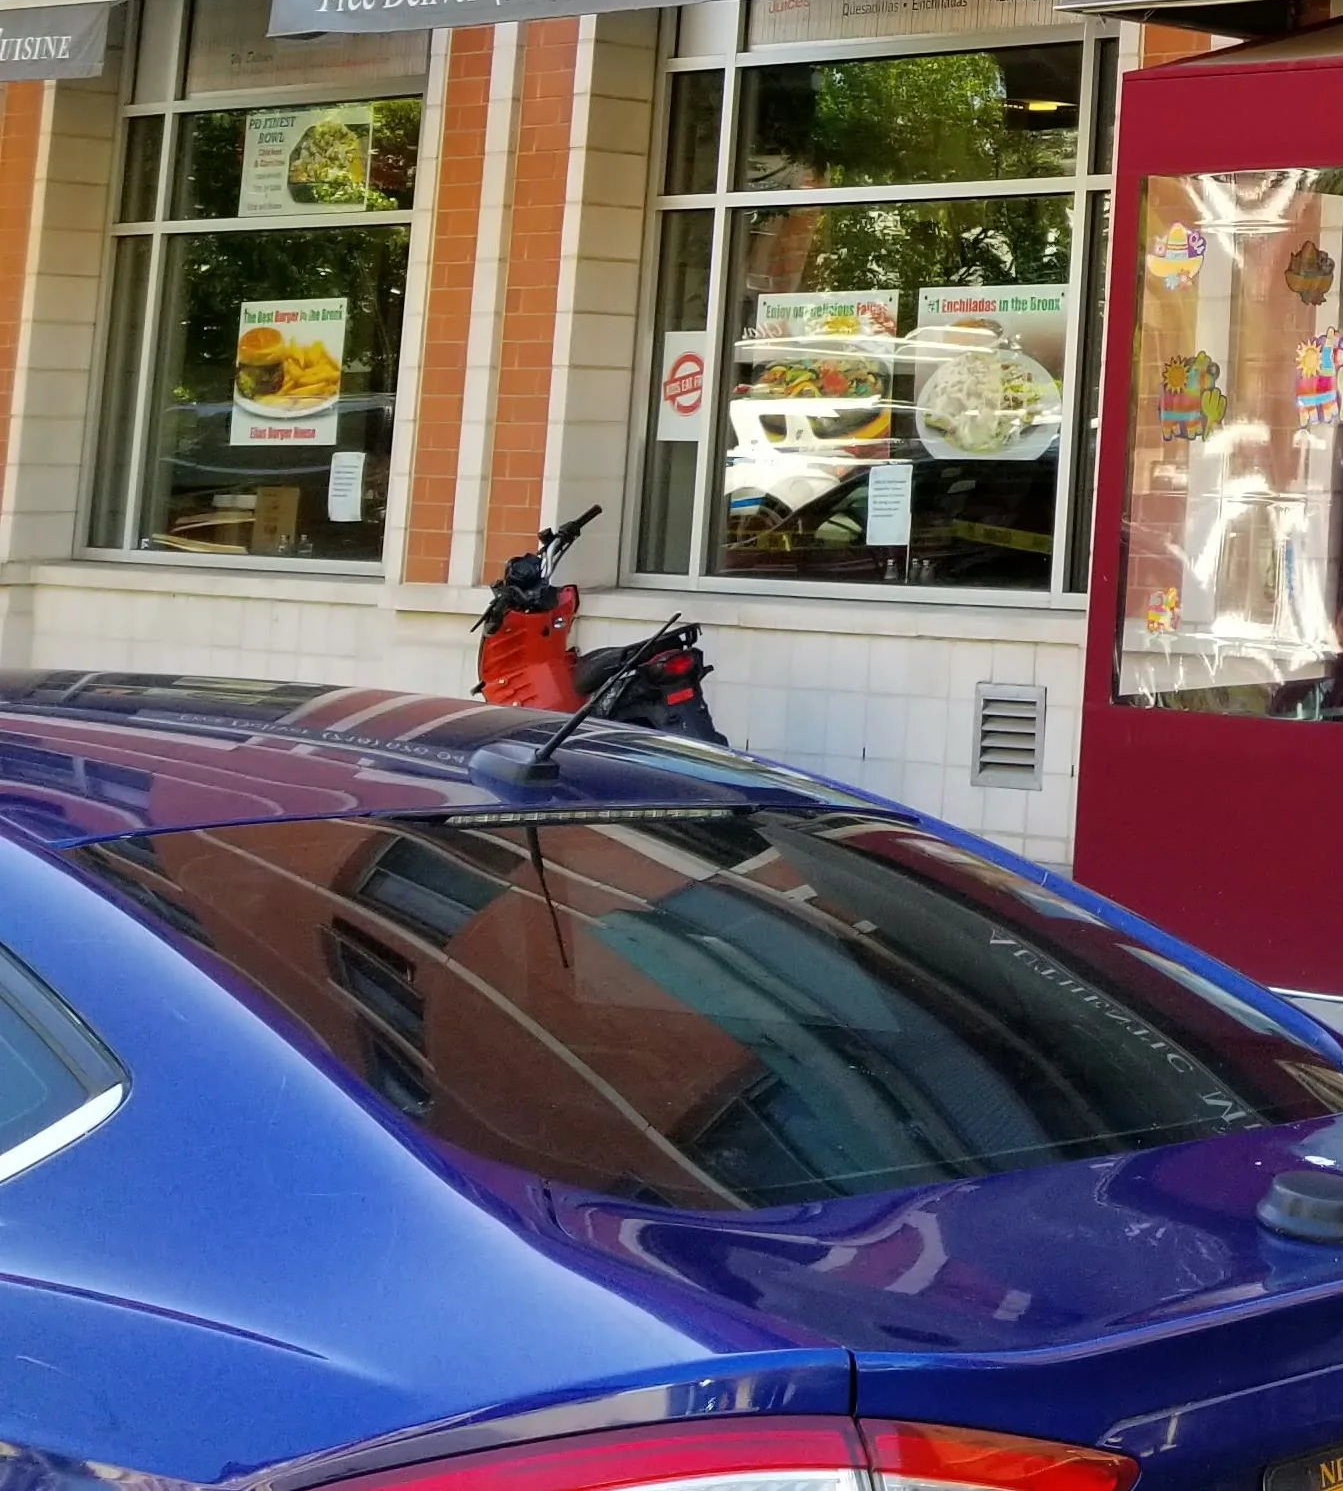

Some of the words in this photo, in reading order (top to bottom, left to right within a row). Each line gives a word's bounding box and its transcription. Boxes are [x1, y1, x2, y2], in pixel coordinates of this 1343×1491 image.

[0, 28, 71, 61] UISINE
[766, 305, 790, 319] Enjoy
[942, 298, 996, 314] Enchiladas
[1012, 296, 1027, 311] the
[1031, 296, 1061, 311] Bronx
[682, 377, 693, 391] EAT
